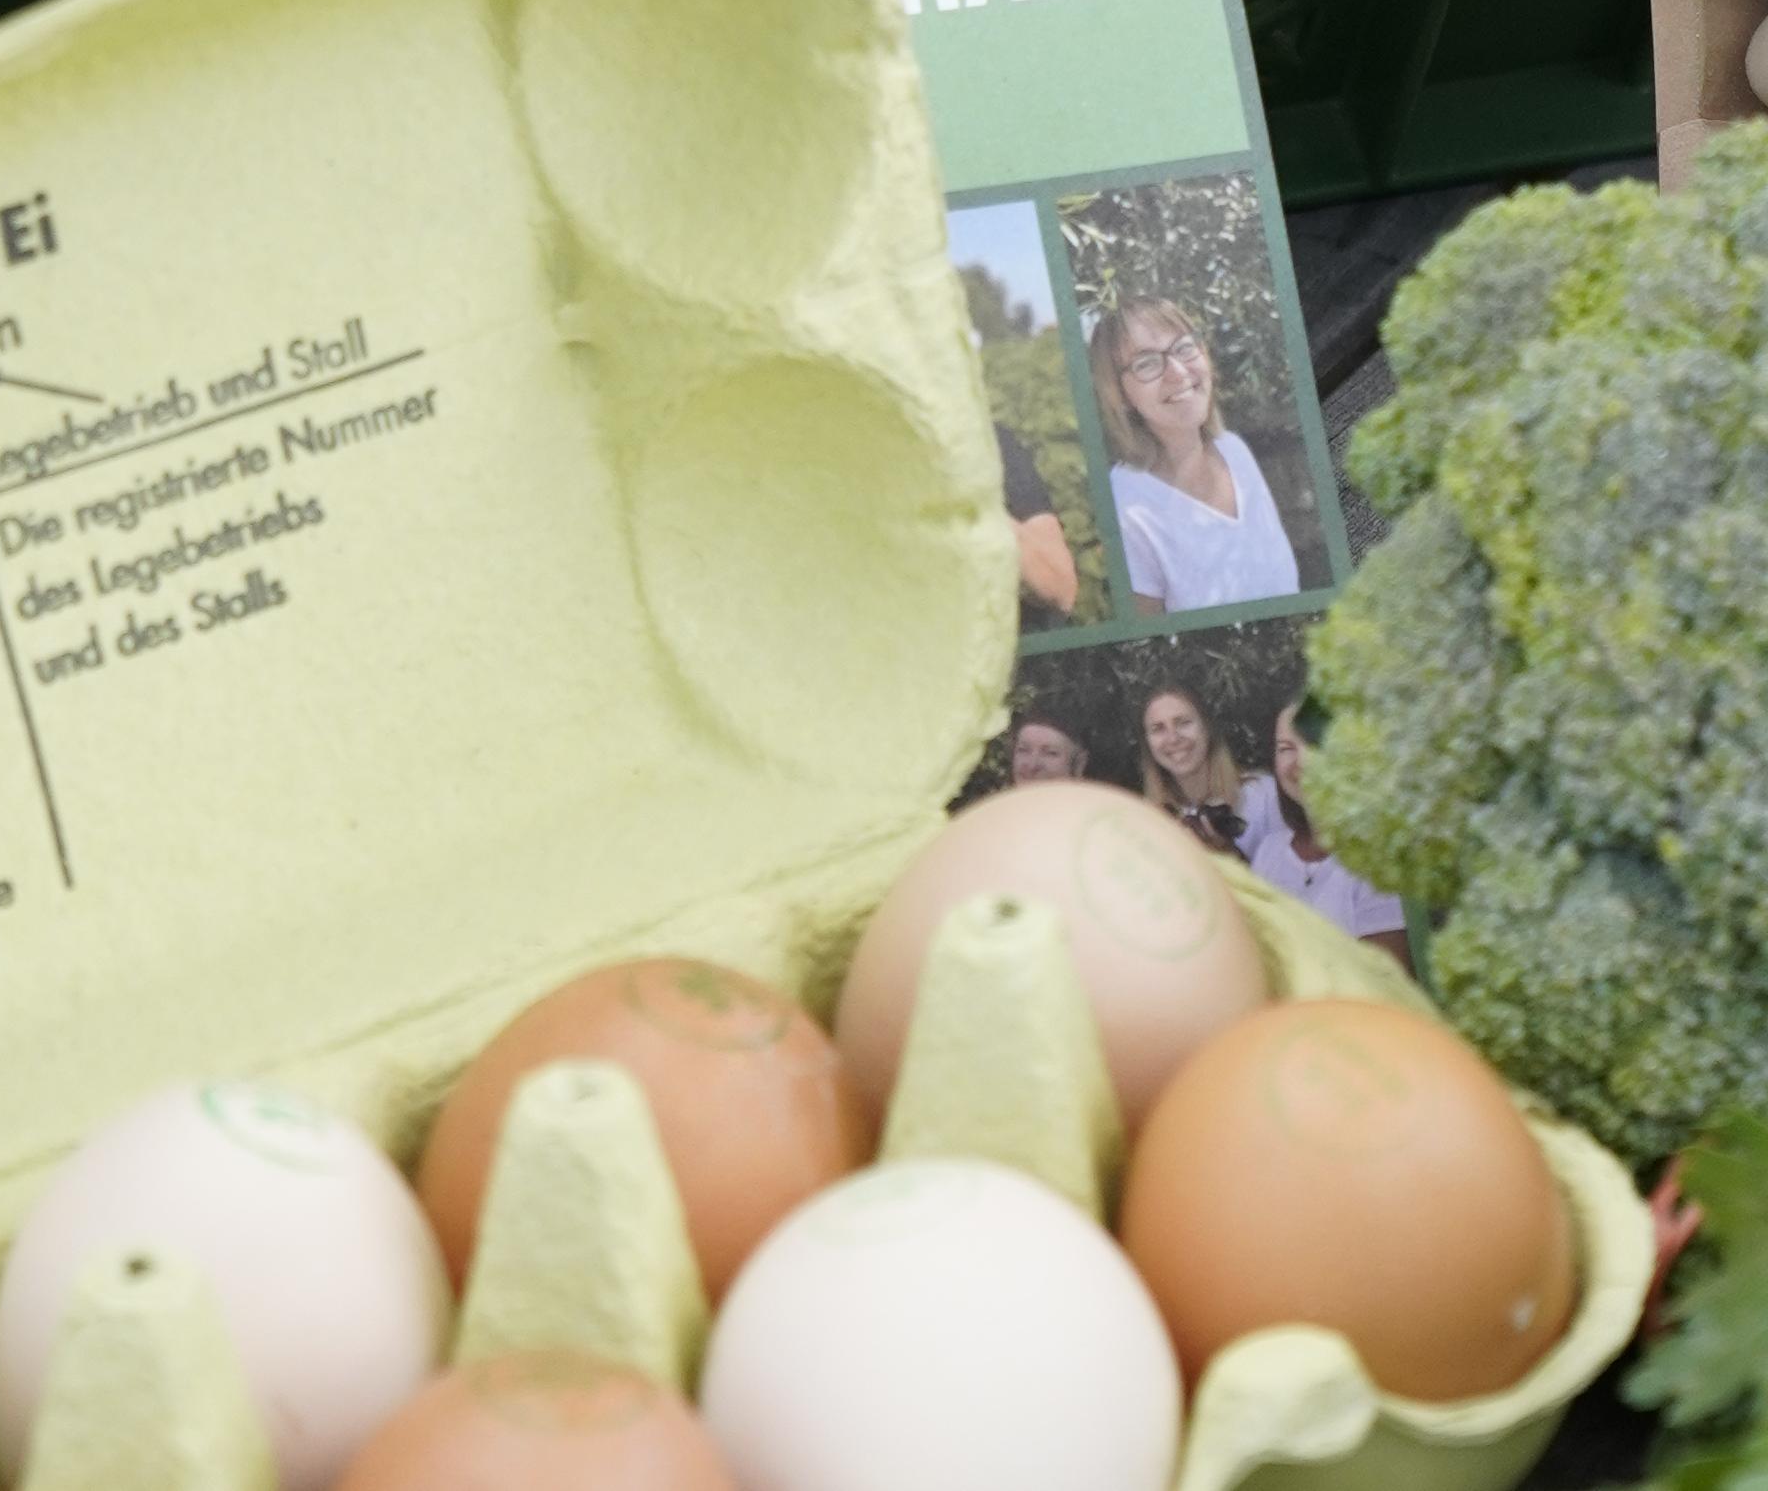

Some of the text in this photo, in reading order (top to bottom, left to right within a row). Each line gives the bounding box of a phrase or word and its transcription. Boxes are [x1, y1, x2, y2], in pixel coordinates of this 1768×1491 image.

[207, 347, 277, 408] und
[288, 317, 370, 383] Stall
[75, 443, 271, 533] registrierte
[277, 386, 441, 465] Nummer
[15, 490, 327, 621] des Legebetriebs
[34, 567, 290, 687] und des Stalls
